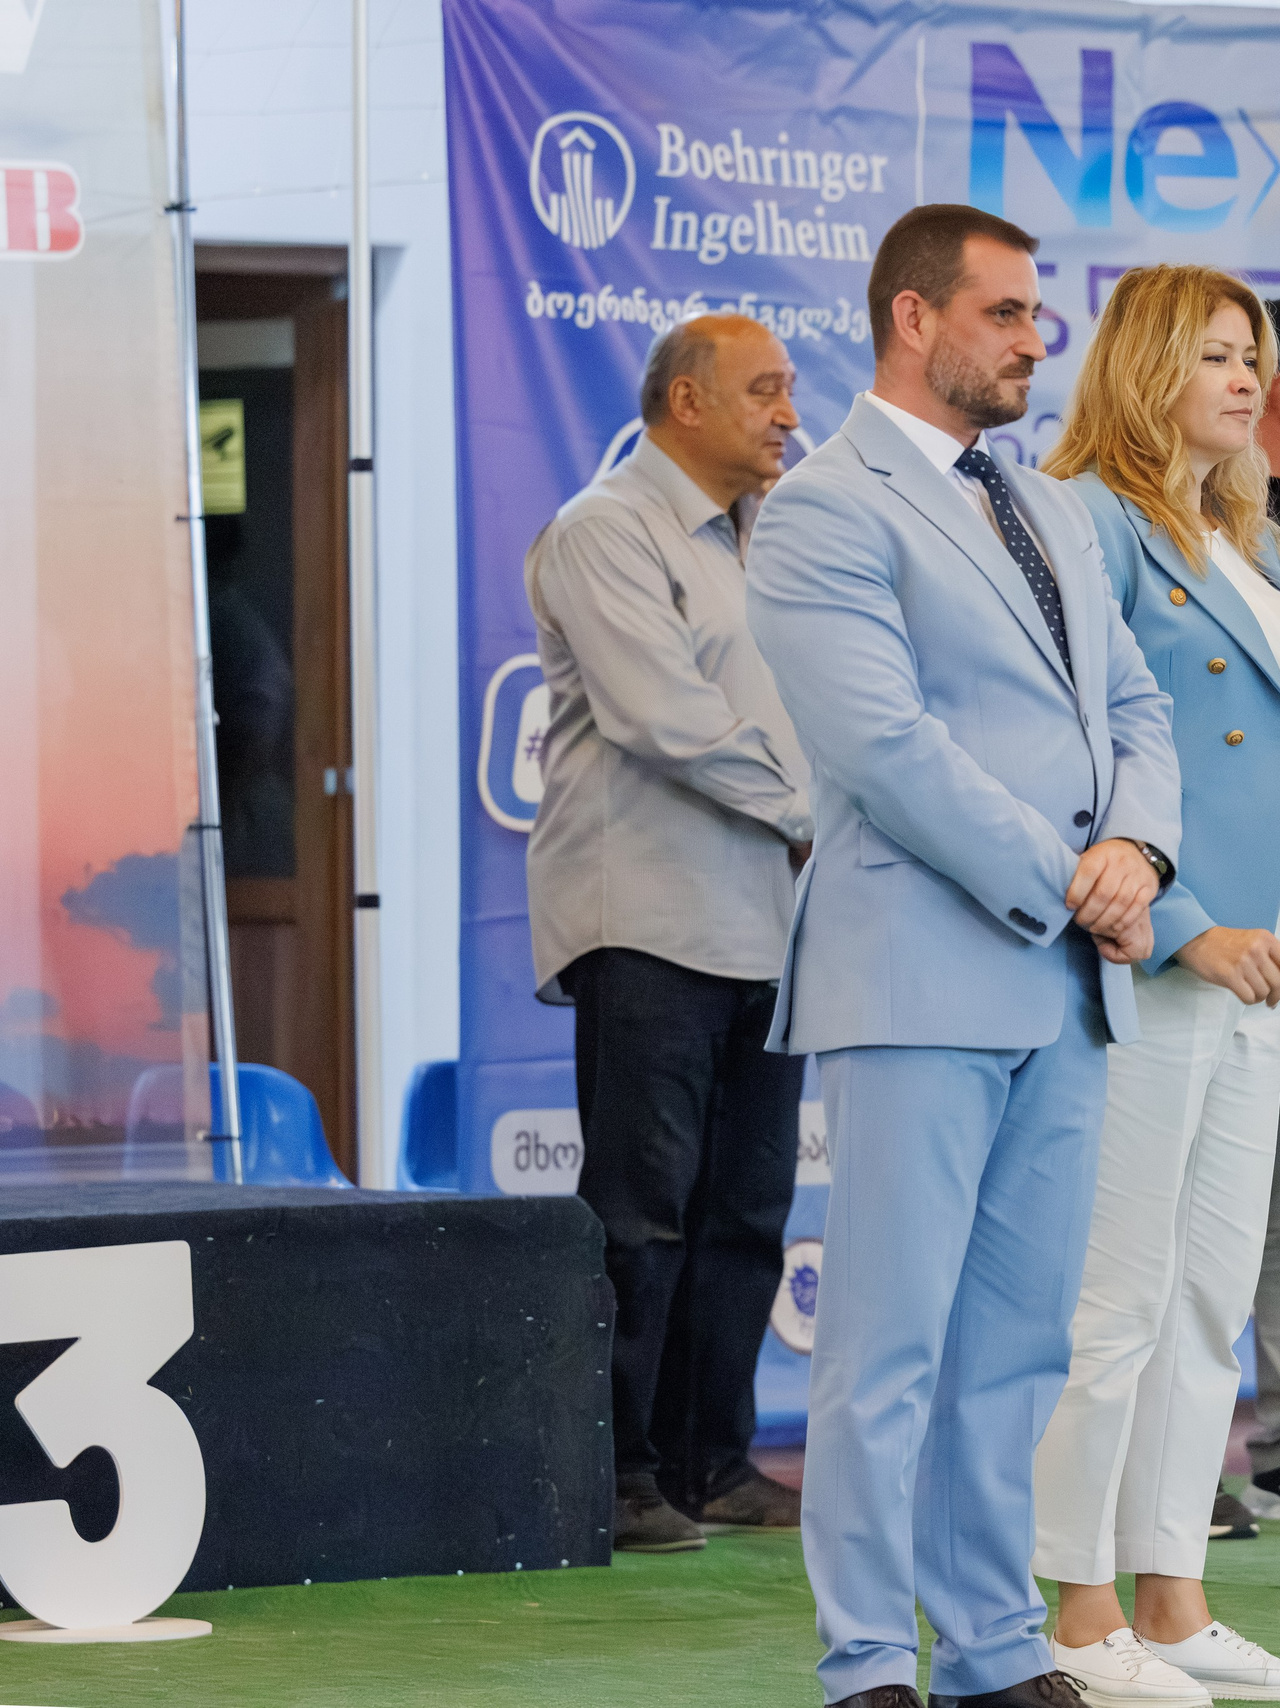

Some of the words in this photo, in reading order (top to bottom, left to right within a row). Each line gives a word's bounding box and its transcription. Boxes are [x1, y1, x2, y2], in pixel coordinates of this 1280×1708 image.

[656, 122, 888, 203] Boehringer
[650, 195, 873, 266] Ingelheim
[0, 1240, 206, 1628] 3
